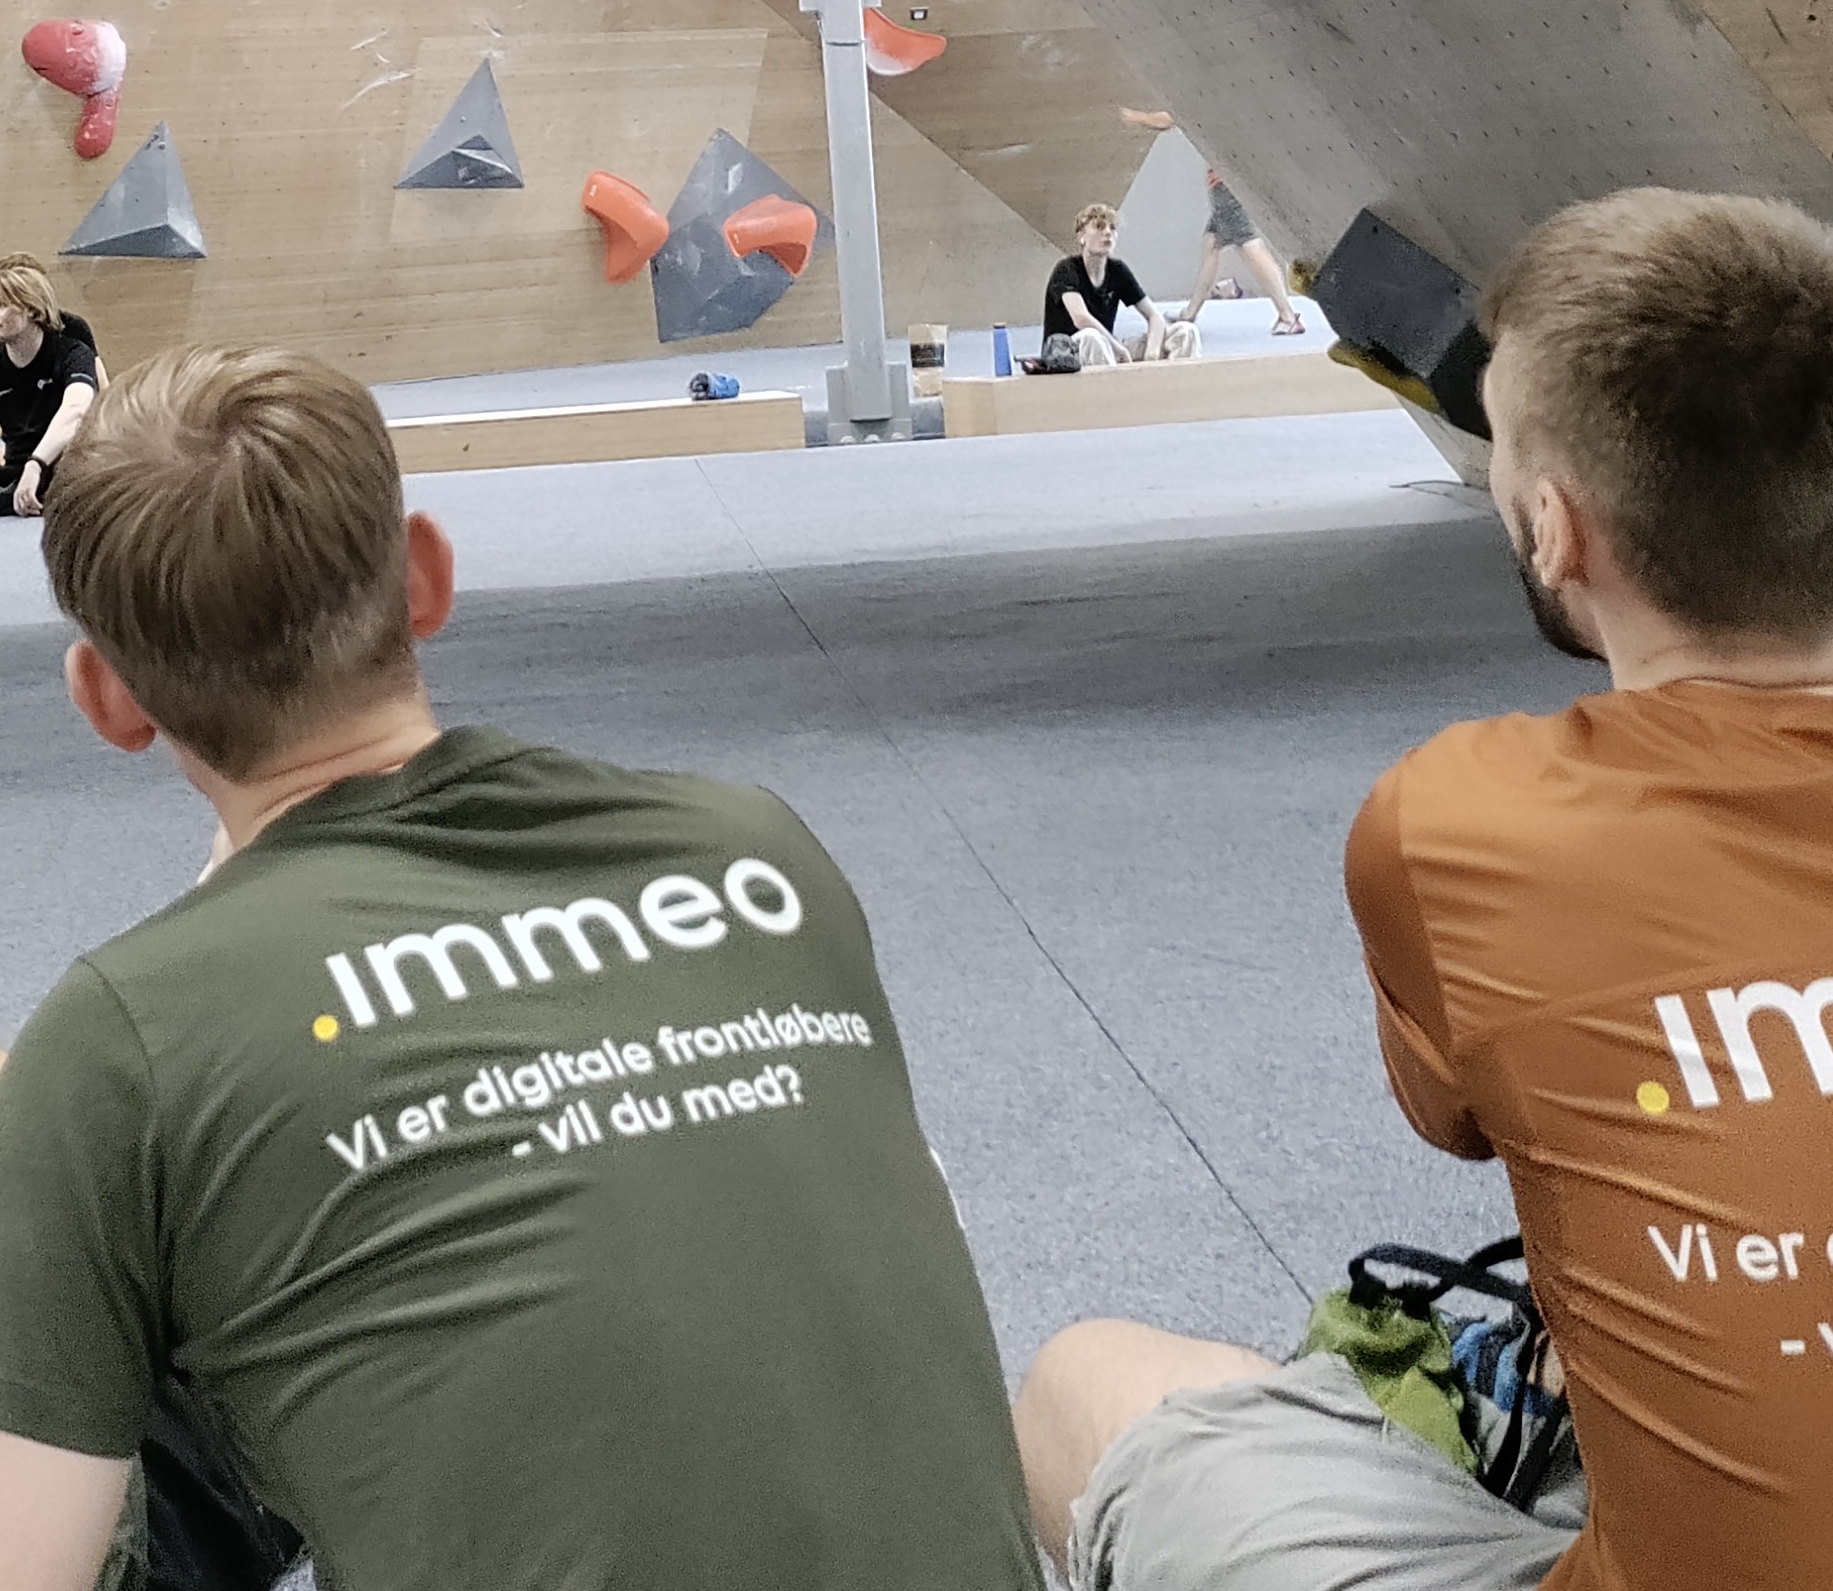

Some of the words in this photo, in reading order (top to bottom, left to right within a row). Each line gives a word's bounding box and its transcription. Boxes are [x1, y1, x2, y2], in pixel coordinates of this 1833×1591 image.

[326, 1115, 389, 1171] Vi
[396, 1092, 451, 1144] er
[463, 1038, 654, 1118] digitale
[656, 1002, 874, 1068] frontløbere
[537, 1098, 603, 1155] vil
[608, 1089, 675, 1138] du
[686, 1063, 807, 1124] med?
[1647, 1223, 1720, 1283] Vi
[1735, 1231, 1805, 1282] er
